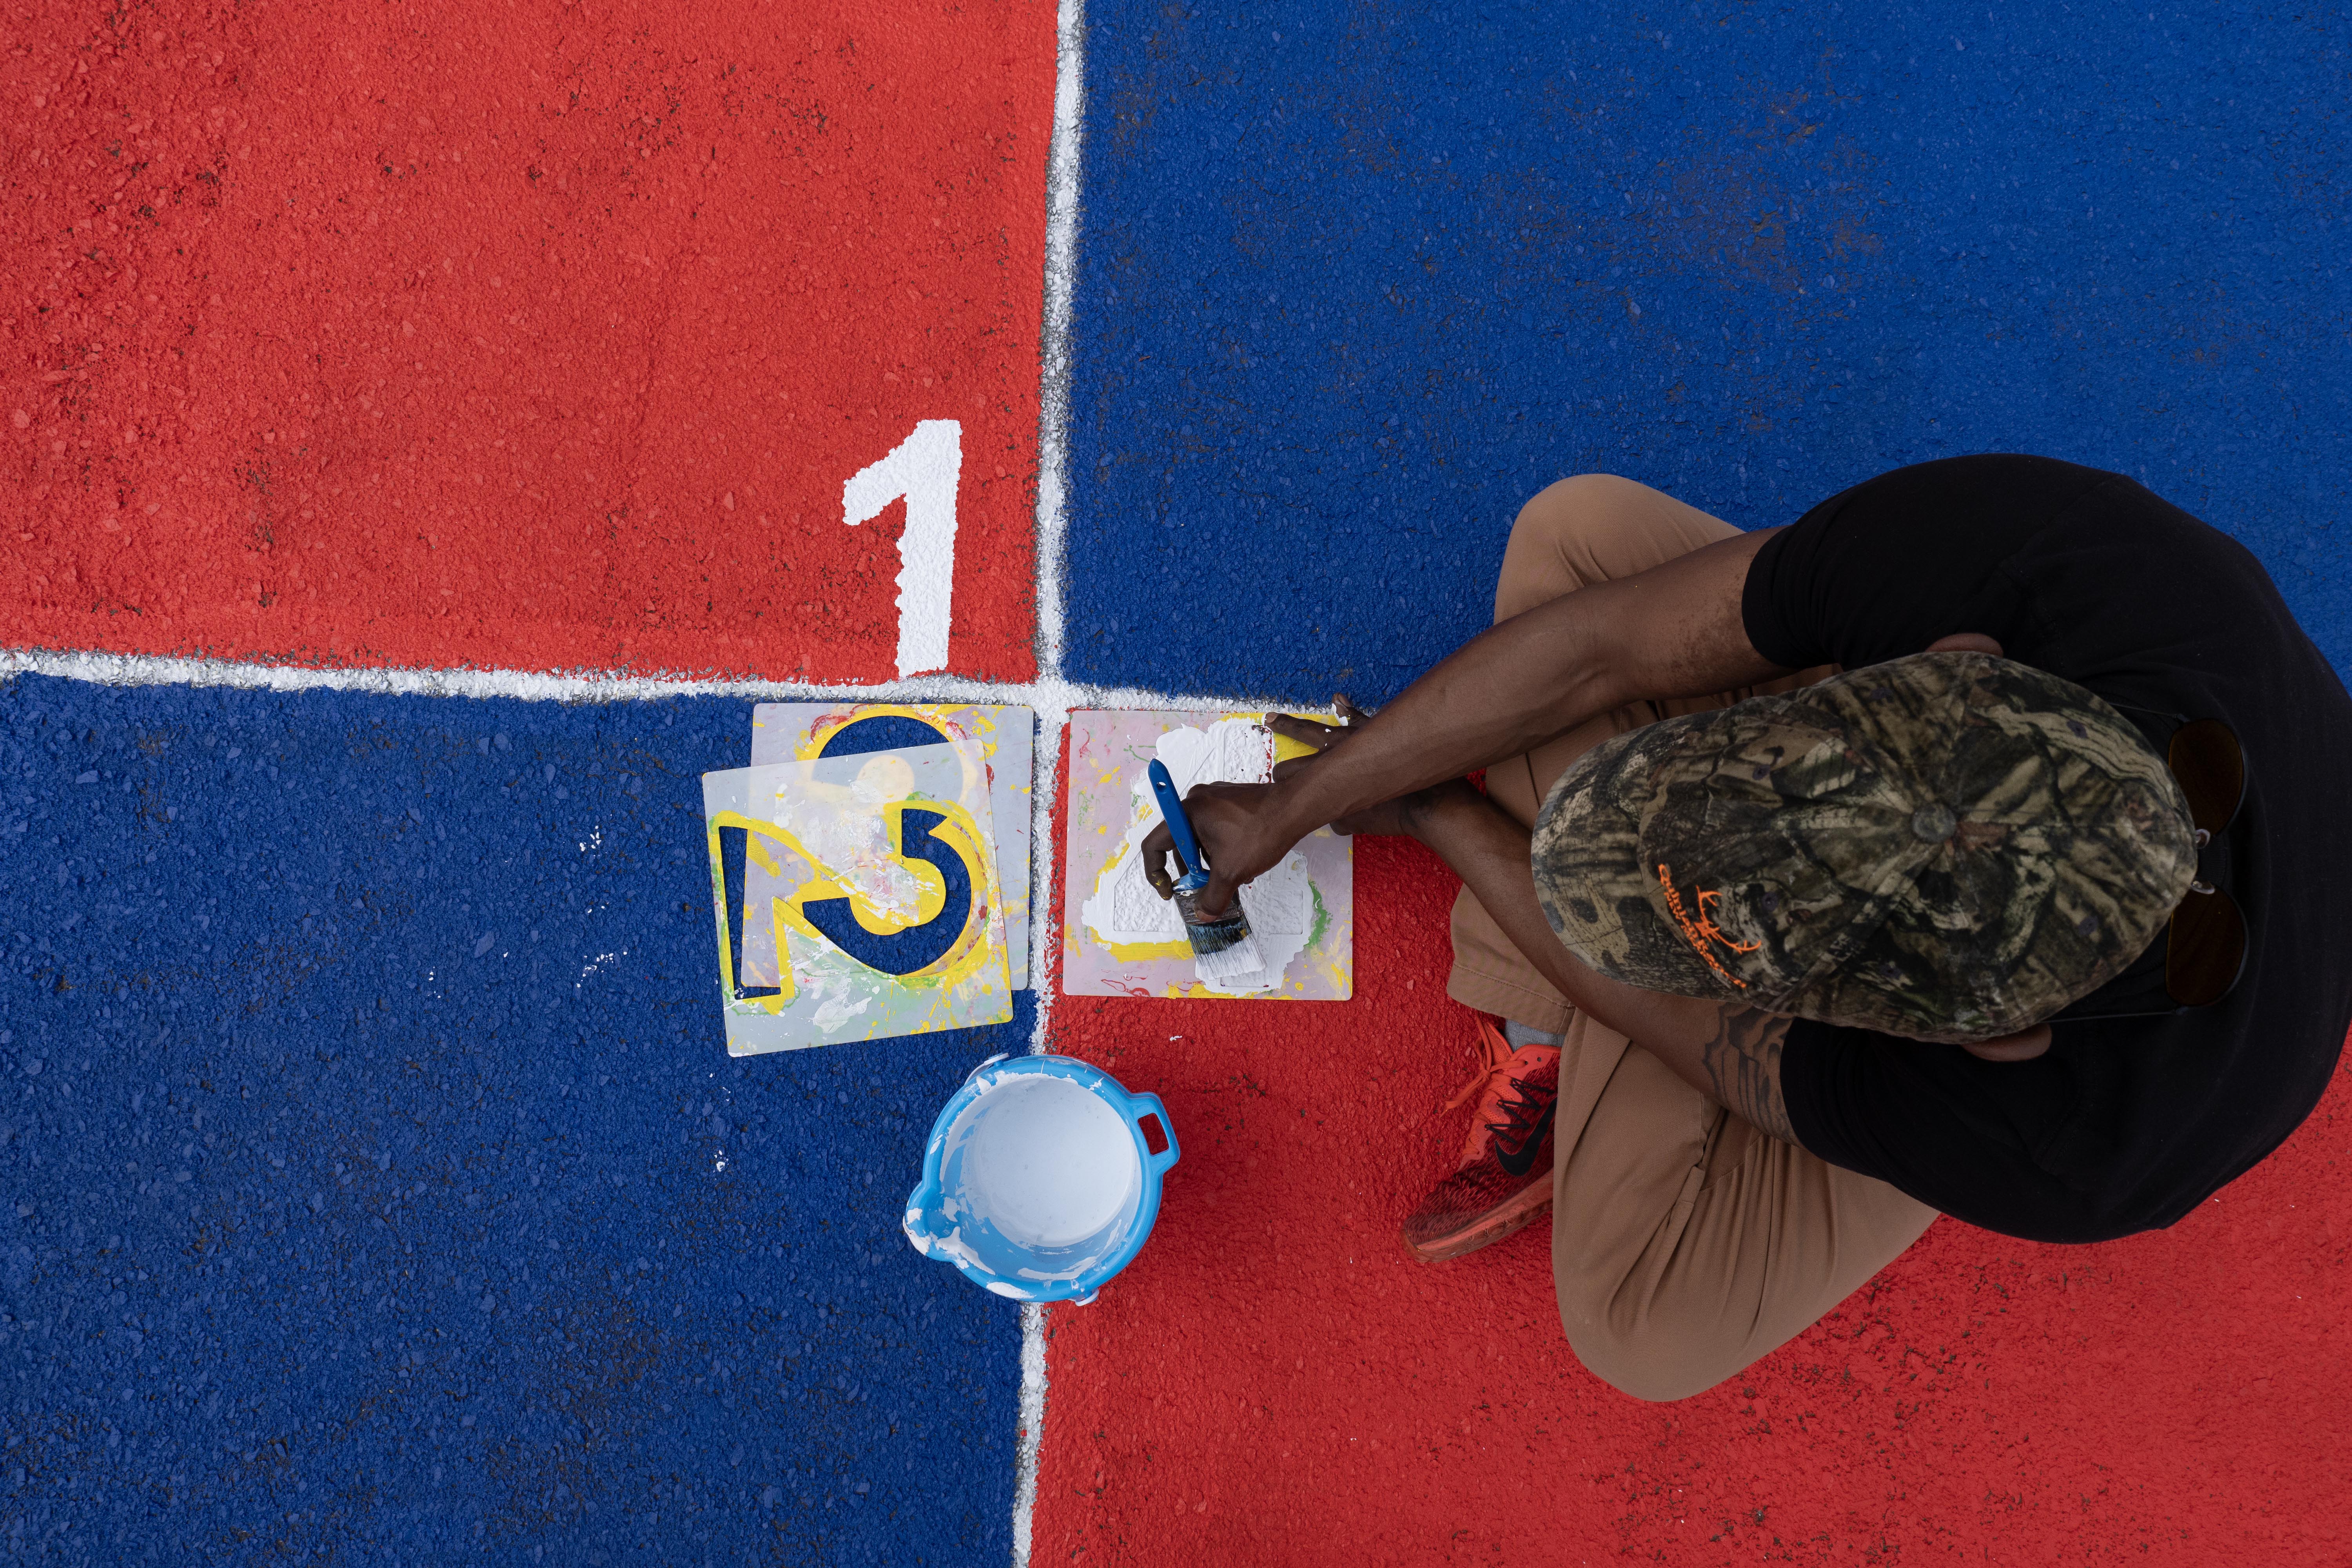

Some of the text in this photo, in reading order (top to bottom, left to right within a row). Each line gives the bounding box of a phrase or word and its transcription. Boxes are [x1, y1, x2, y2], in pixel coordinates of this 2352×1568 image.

[842, 419, 962, 677] 1
[1658, 864, 1698, 938] Quinlan
[1664, 891, 1681, 920] NEW
